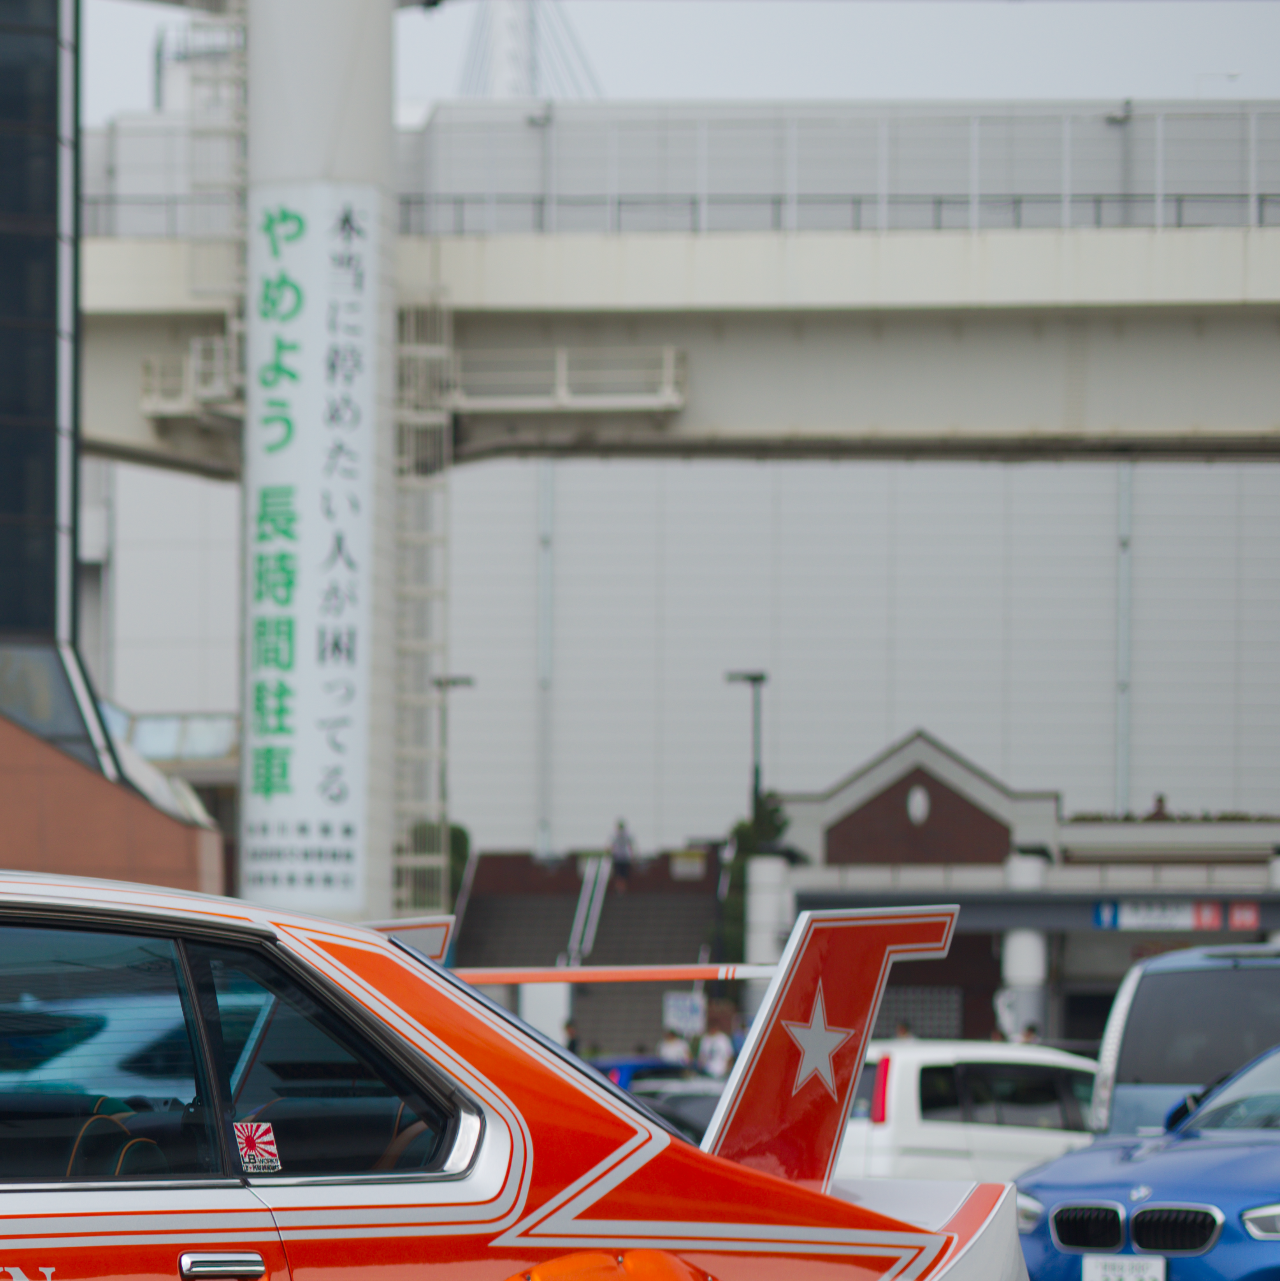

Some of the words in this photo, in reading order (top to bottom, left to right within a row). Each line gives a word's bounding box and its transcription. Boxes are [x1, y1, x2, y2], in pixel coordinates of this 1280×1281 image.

[259, 206, 305, 454] やめよう
[251, 484, 299, 803] 長時間駐車
[241, 1153, 256, 1164] LB
